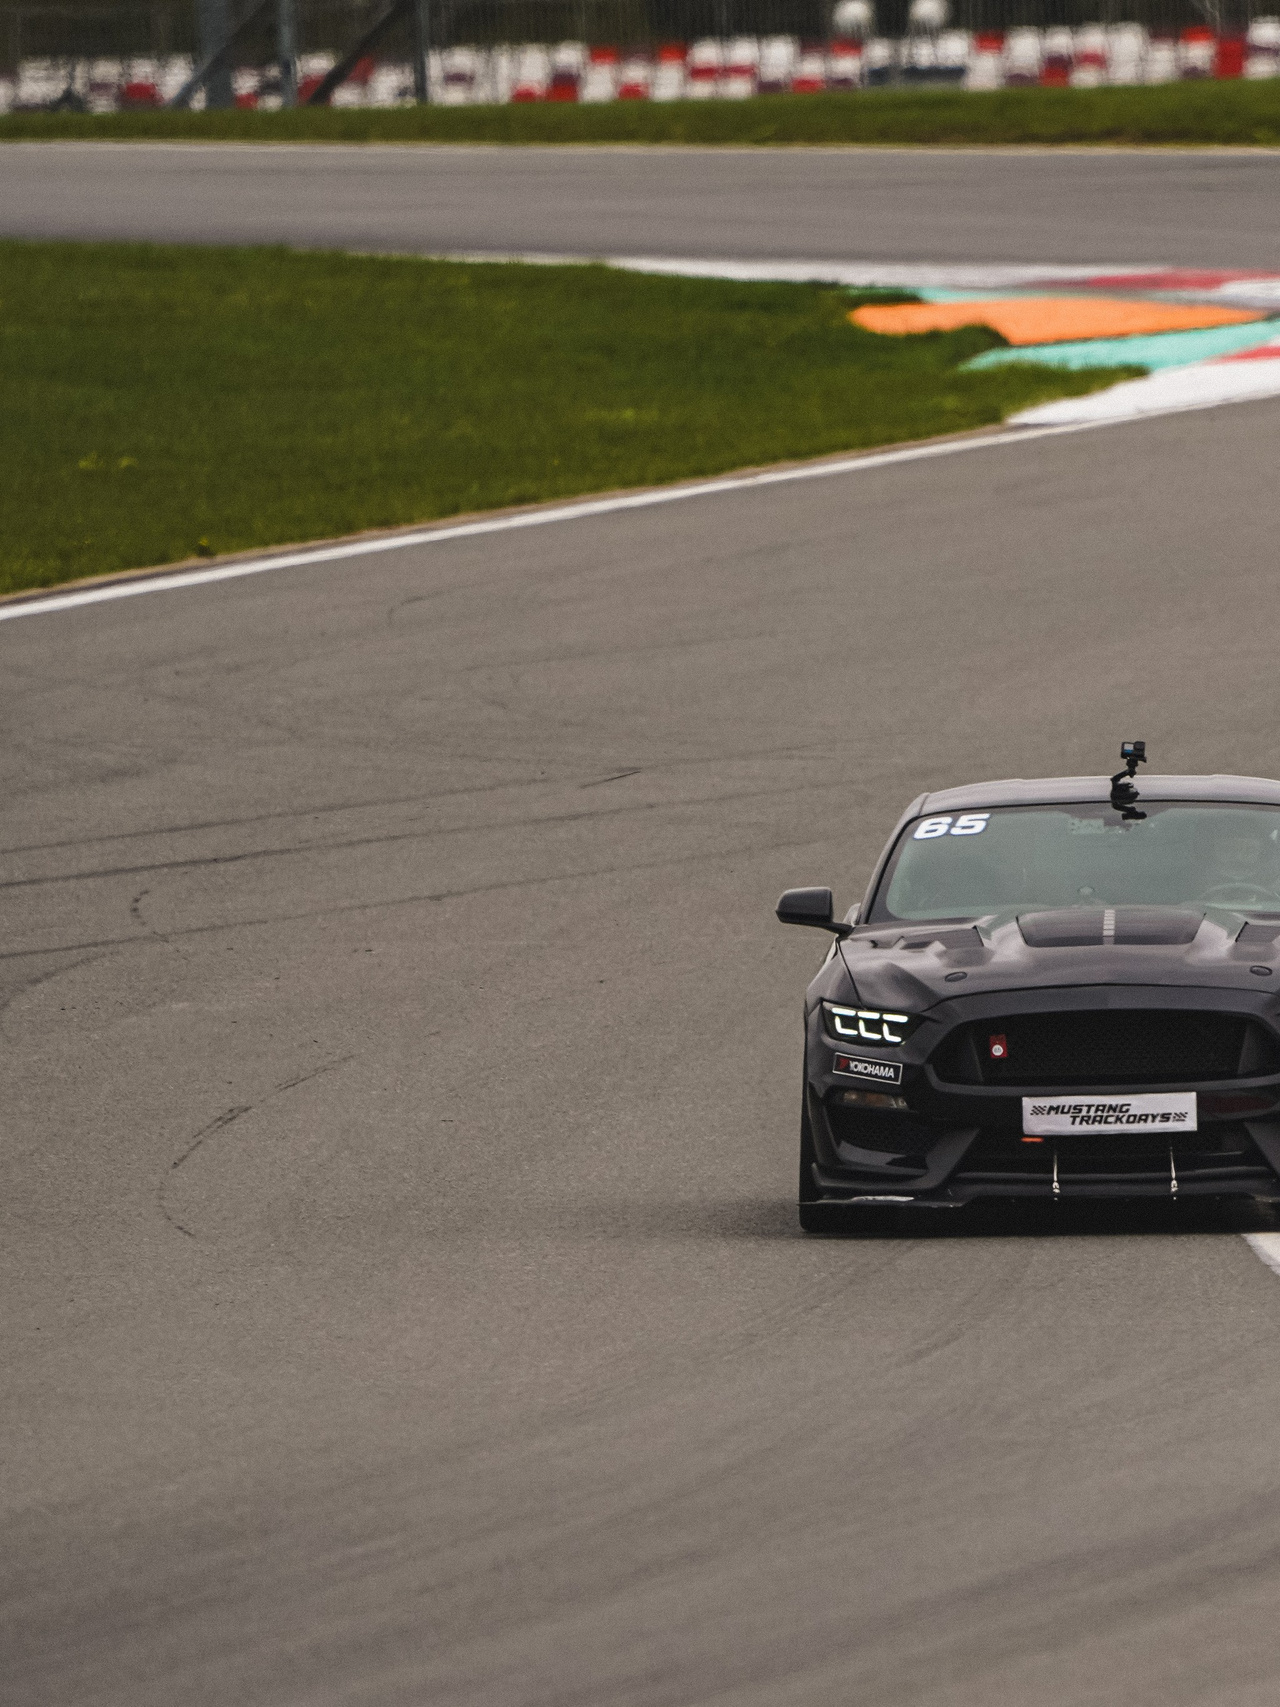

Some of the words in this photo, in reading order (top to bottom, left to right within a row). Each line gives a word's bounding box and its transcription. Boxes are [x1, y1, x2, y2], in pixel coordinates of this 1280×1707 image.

[913, 813, 990, 840] 65
[849, 1060, 895, 1079] YOKOHAMA
[1046, 1103, 1132, 1115] MUSTANG
[1069, 1112, 1172, 1126] TRACKDAYS
